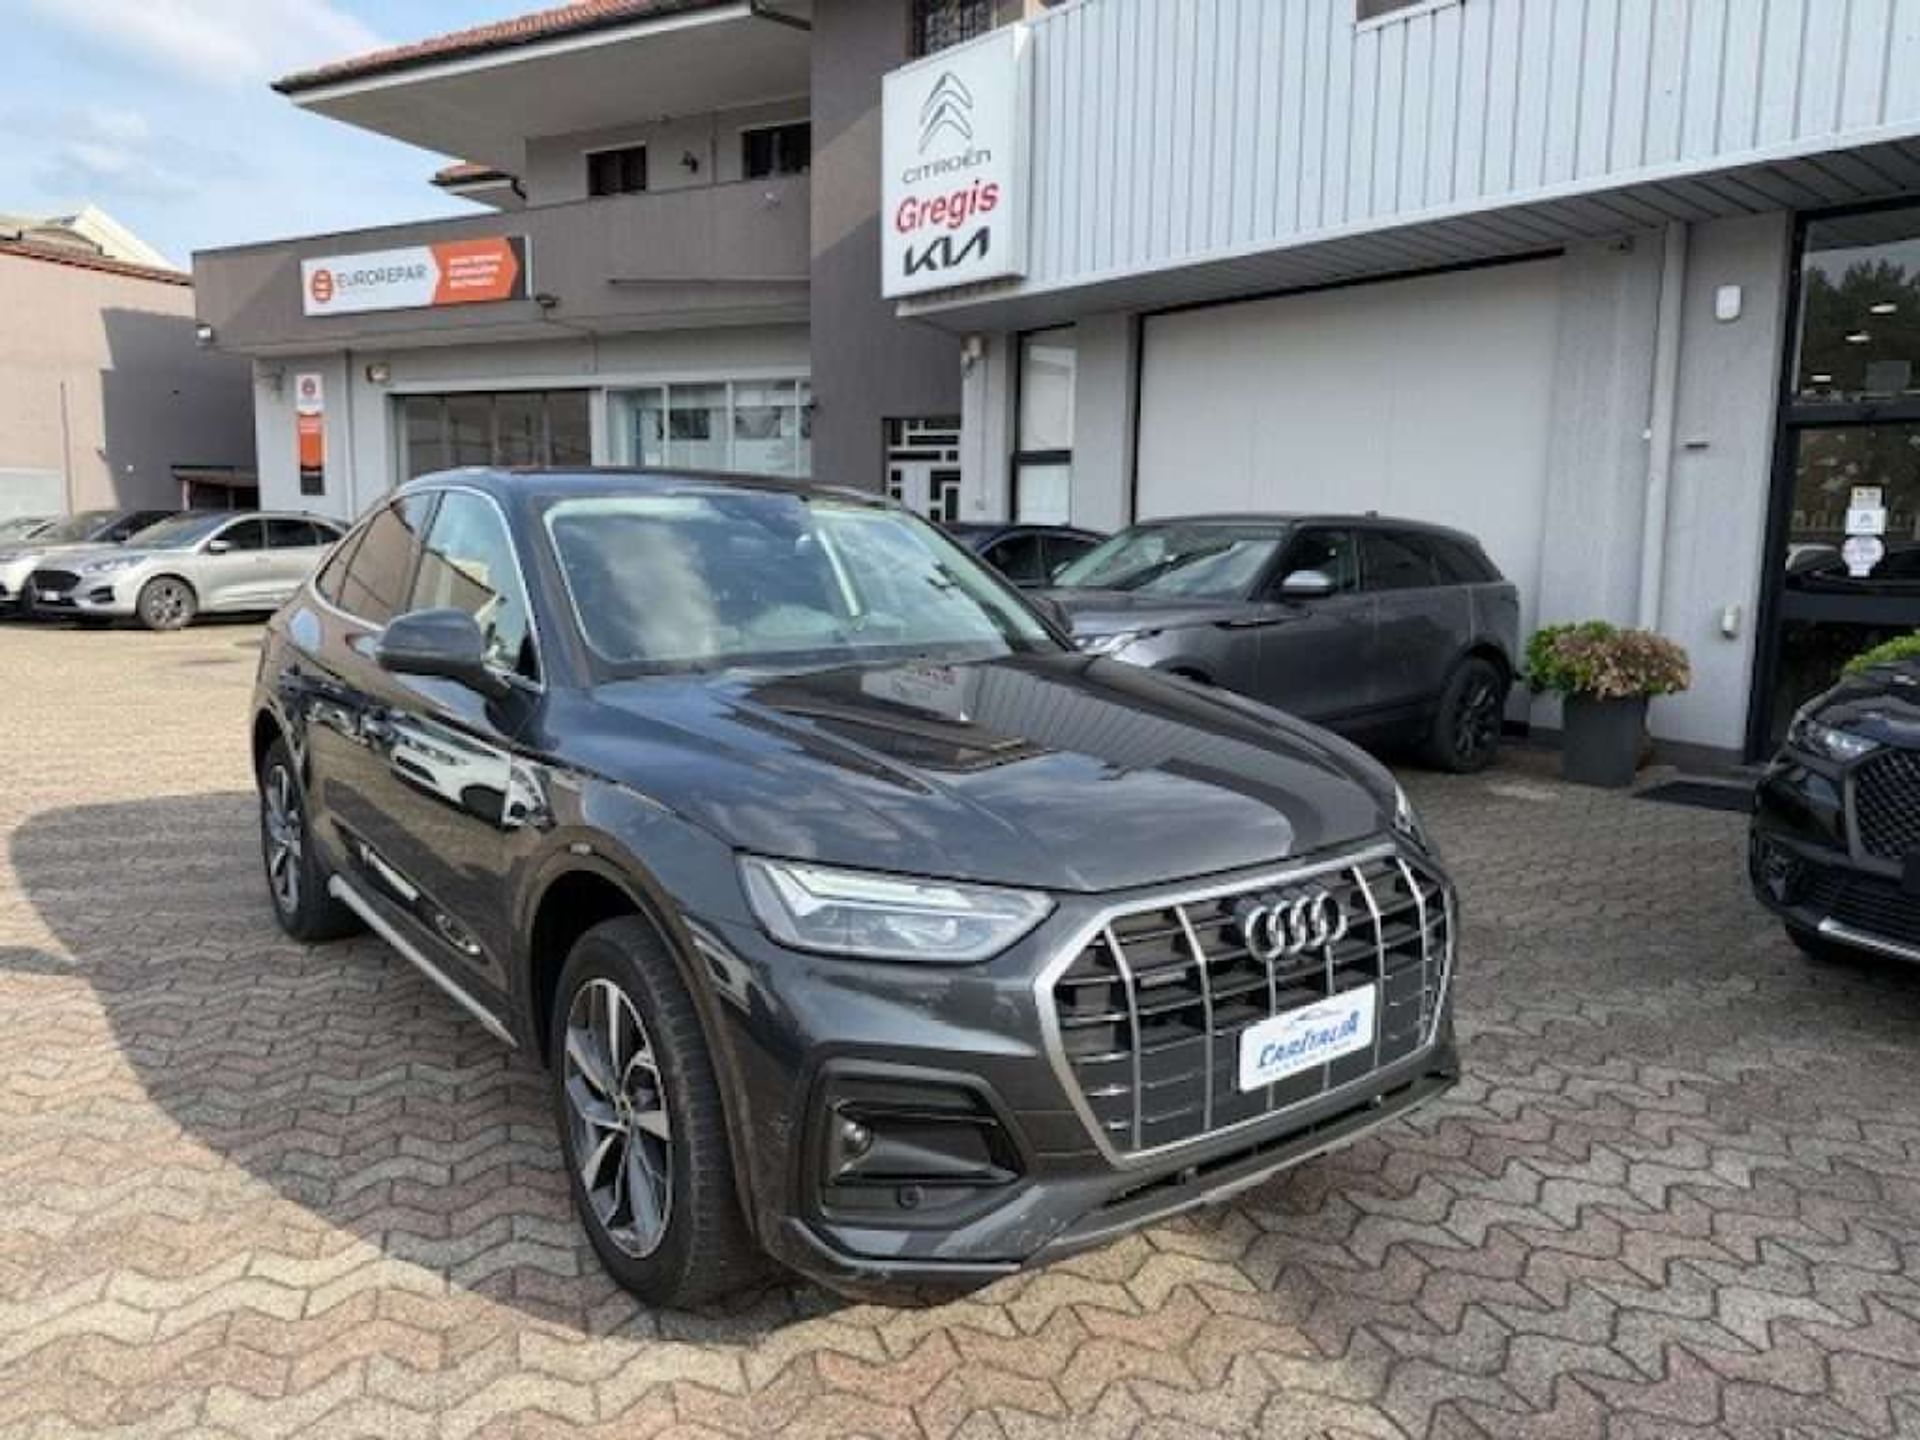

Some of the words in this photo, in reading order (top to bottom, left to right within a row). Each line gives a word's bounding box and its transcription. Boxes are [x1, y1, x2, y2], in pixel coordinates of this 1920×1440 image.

[896, 179, 999, 233] Gregis
[904, 226, 990, 275] KIA
[336, 264, 428, 289] EUROREPAR
